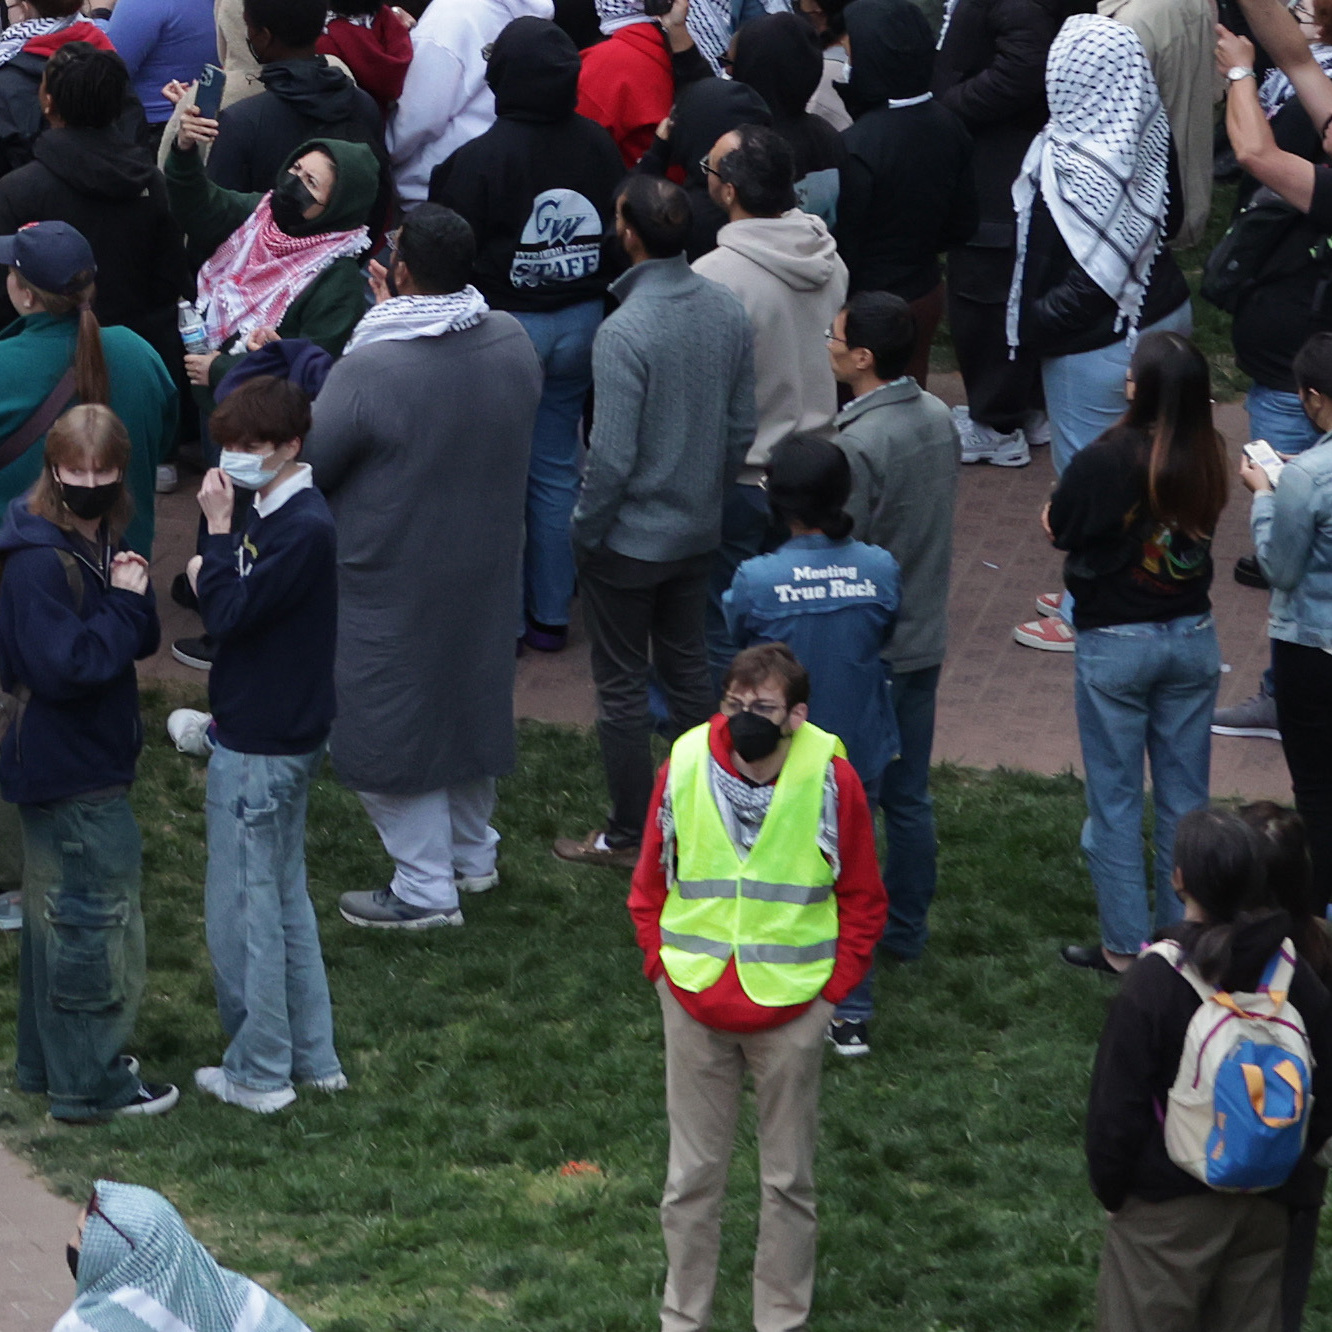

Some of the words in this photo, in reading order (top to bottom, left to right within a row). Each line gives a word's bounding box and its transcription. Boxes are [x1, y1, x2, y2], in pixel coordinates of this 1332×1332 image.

[535, 199, 594, 247] GW
[512, 253, 602, 286] STAFF
[793, 564, 858, 583] Meeting
[774, 583, 828, 603] True
[829, 579, 877, 600] Rock
